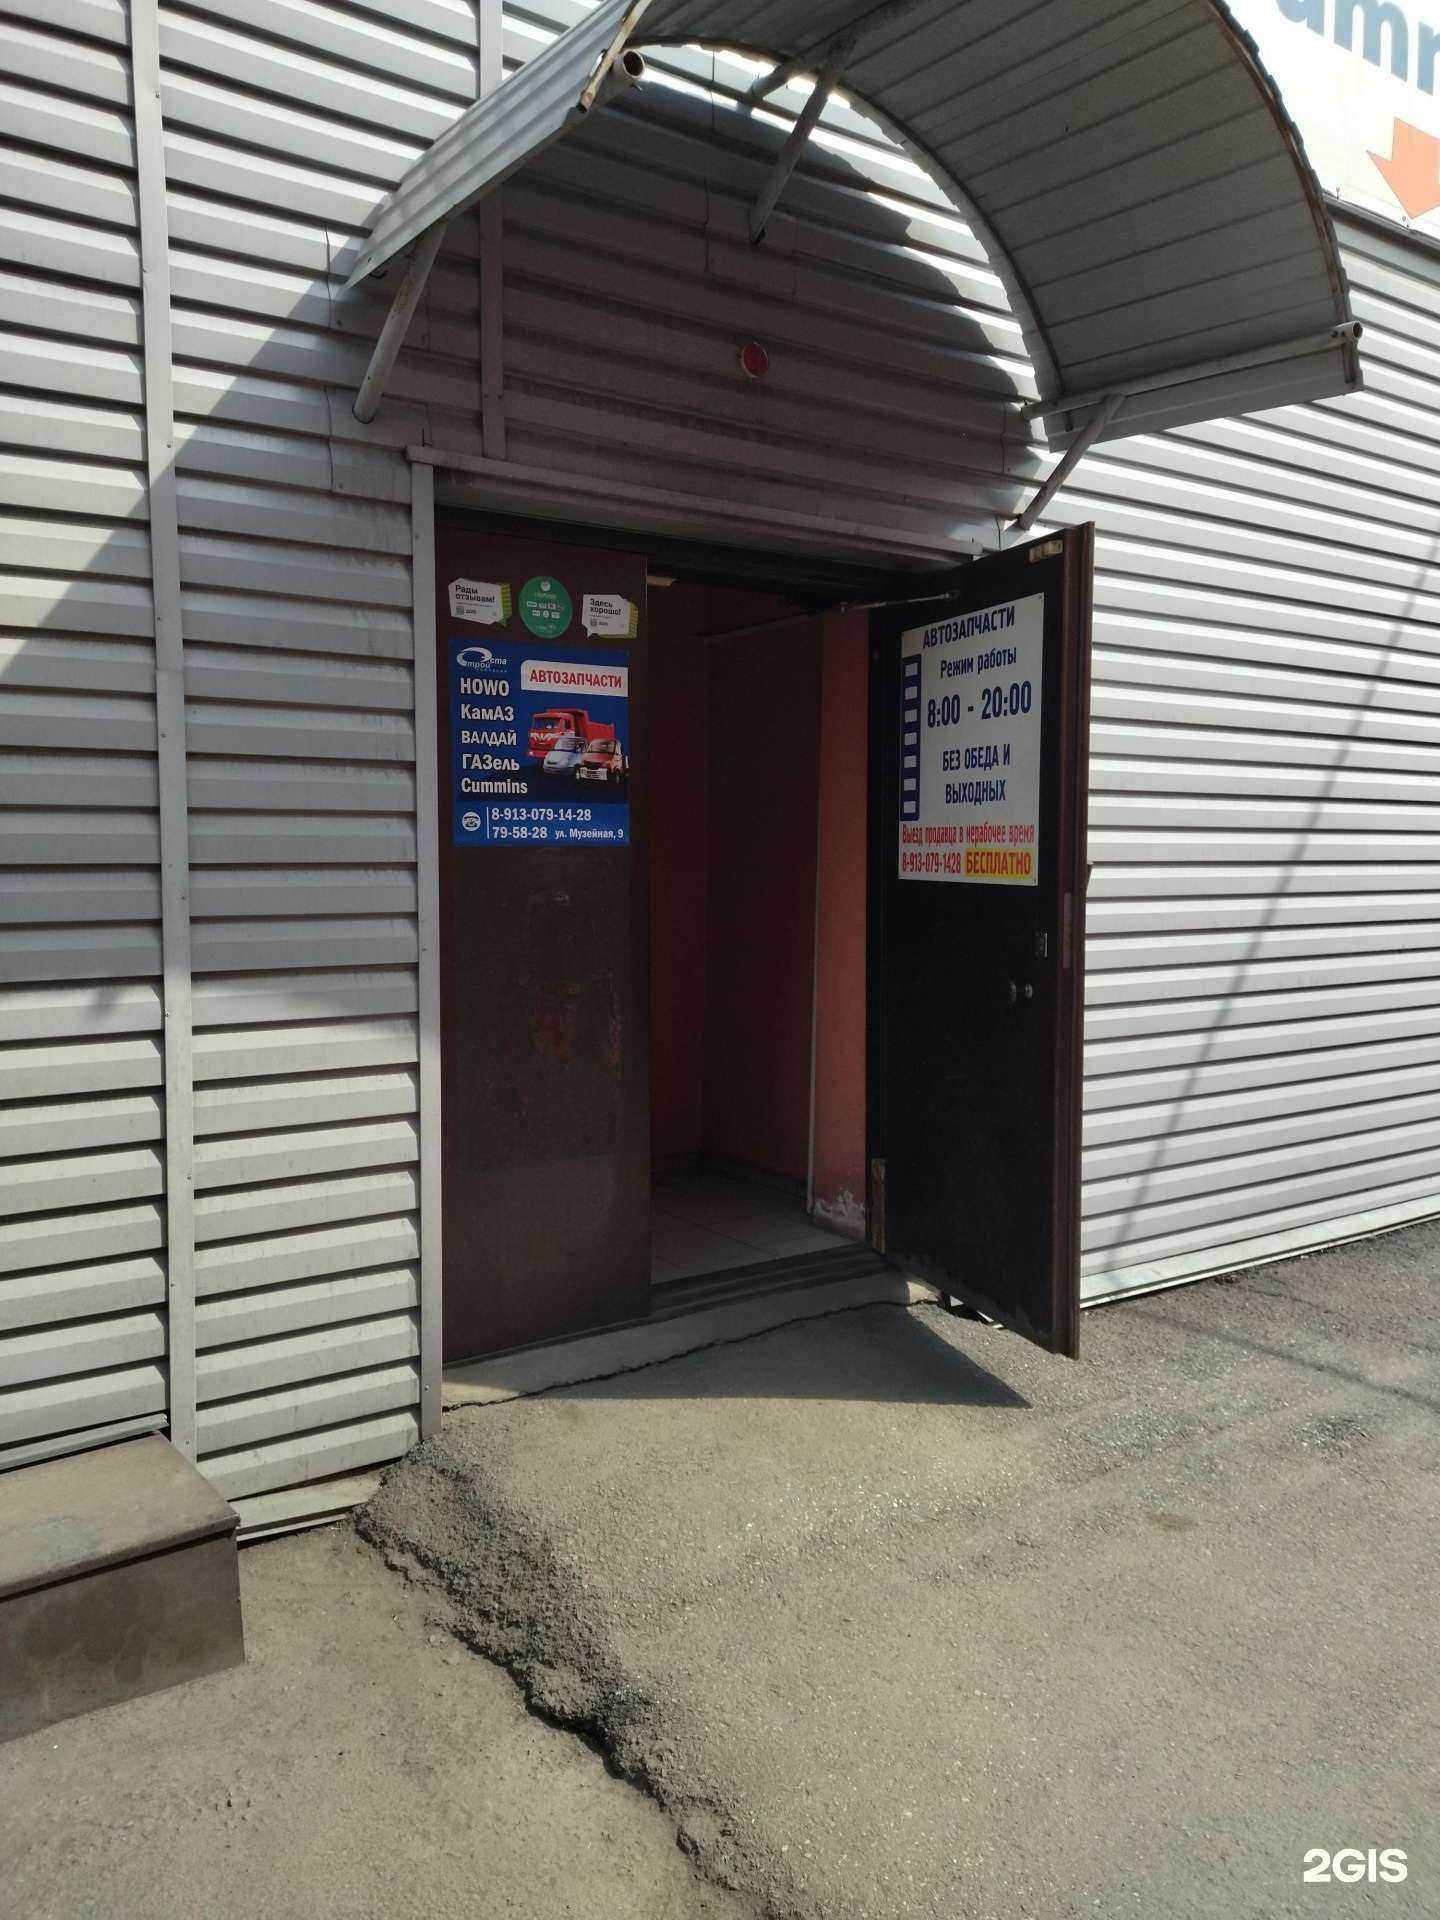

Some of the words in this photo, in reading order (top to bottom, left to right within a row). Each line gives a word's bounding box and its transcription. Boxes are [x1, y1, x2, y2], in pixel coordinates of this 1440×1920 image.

[922, 606, 1015, 649] АВТОЗАПЧАСТИ
[940, 656, 974, 679] Режим
[977, 646, 1017, 672] работы
[460, 678, 510, 696] HOWO
[530, 669, 622, 688] АВТОЗАПЧАСТИ
[461, 704, 514, 721] КамАЗ
[928, 694, 960, 728] 8:00
[981, 680, 1032, 720] 20:00
[462, 729, 517, 747] ВАЛДАЙ
[462, 754, 520, 770] ГАЗель
[942, 750, 960, 771] БЕЗ
[964, 745, 999, 771] ОБЕДА
[1003, 743, 1010, 766] И
[462, 778, 528, 794] Cummins
[945, 780, 1006, 806] ВЫХОДНЫХ
[491, 808, 591, 821] 8-913-079-14-28
[492, 827, 548, 839] 79-58-28
[555, 830, 567, 839] ул.
[569, 828, 615, 839] Музейная,
[618, 830, 624, 838] 9
[902, 824, 923, 846] Выезд
[925, 826, 957, 846] продавца
[959, 828, 964, 842] в
[966, 824, 1006, 848] нерабочее
[1008, 826, 1034, 848] время
[902, 851, 961, 874] 8-913-079-1428
[966, 851, 1031, 874] БЕСПЛАТНО
